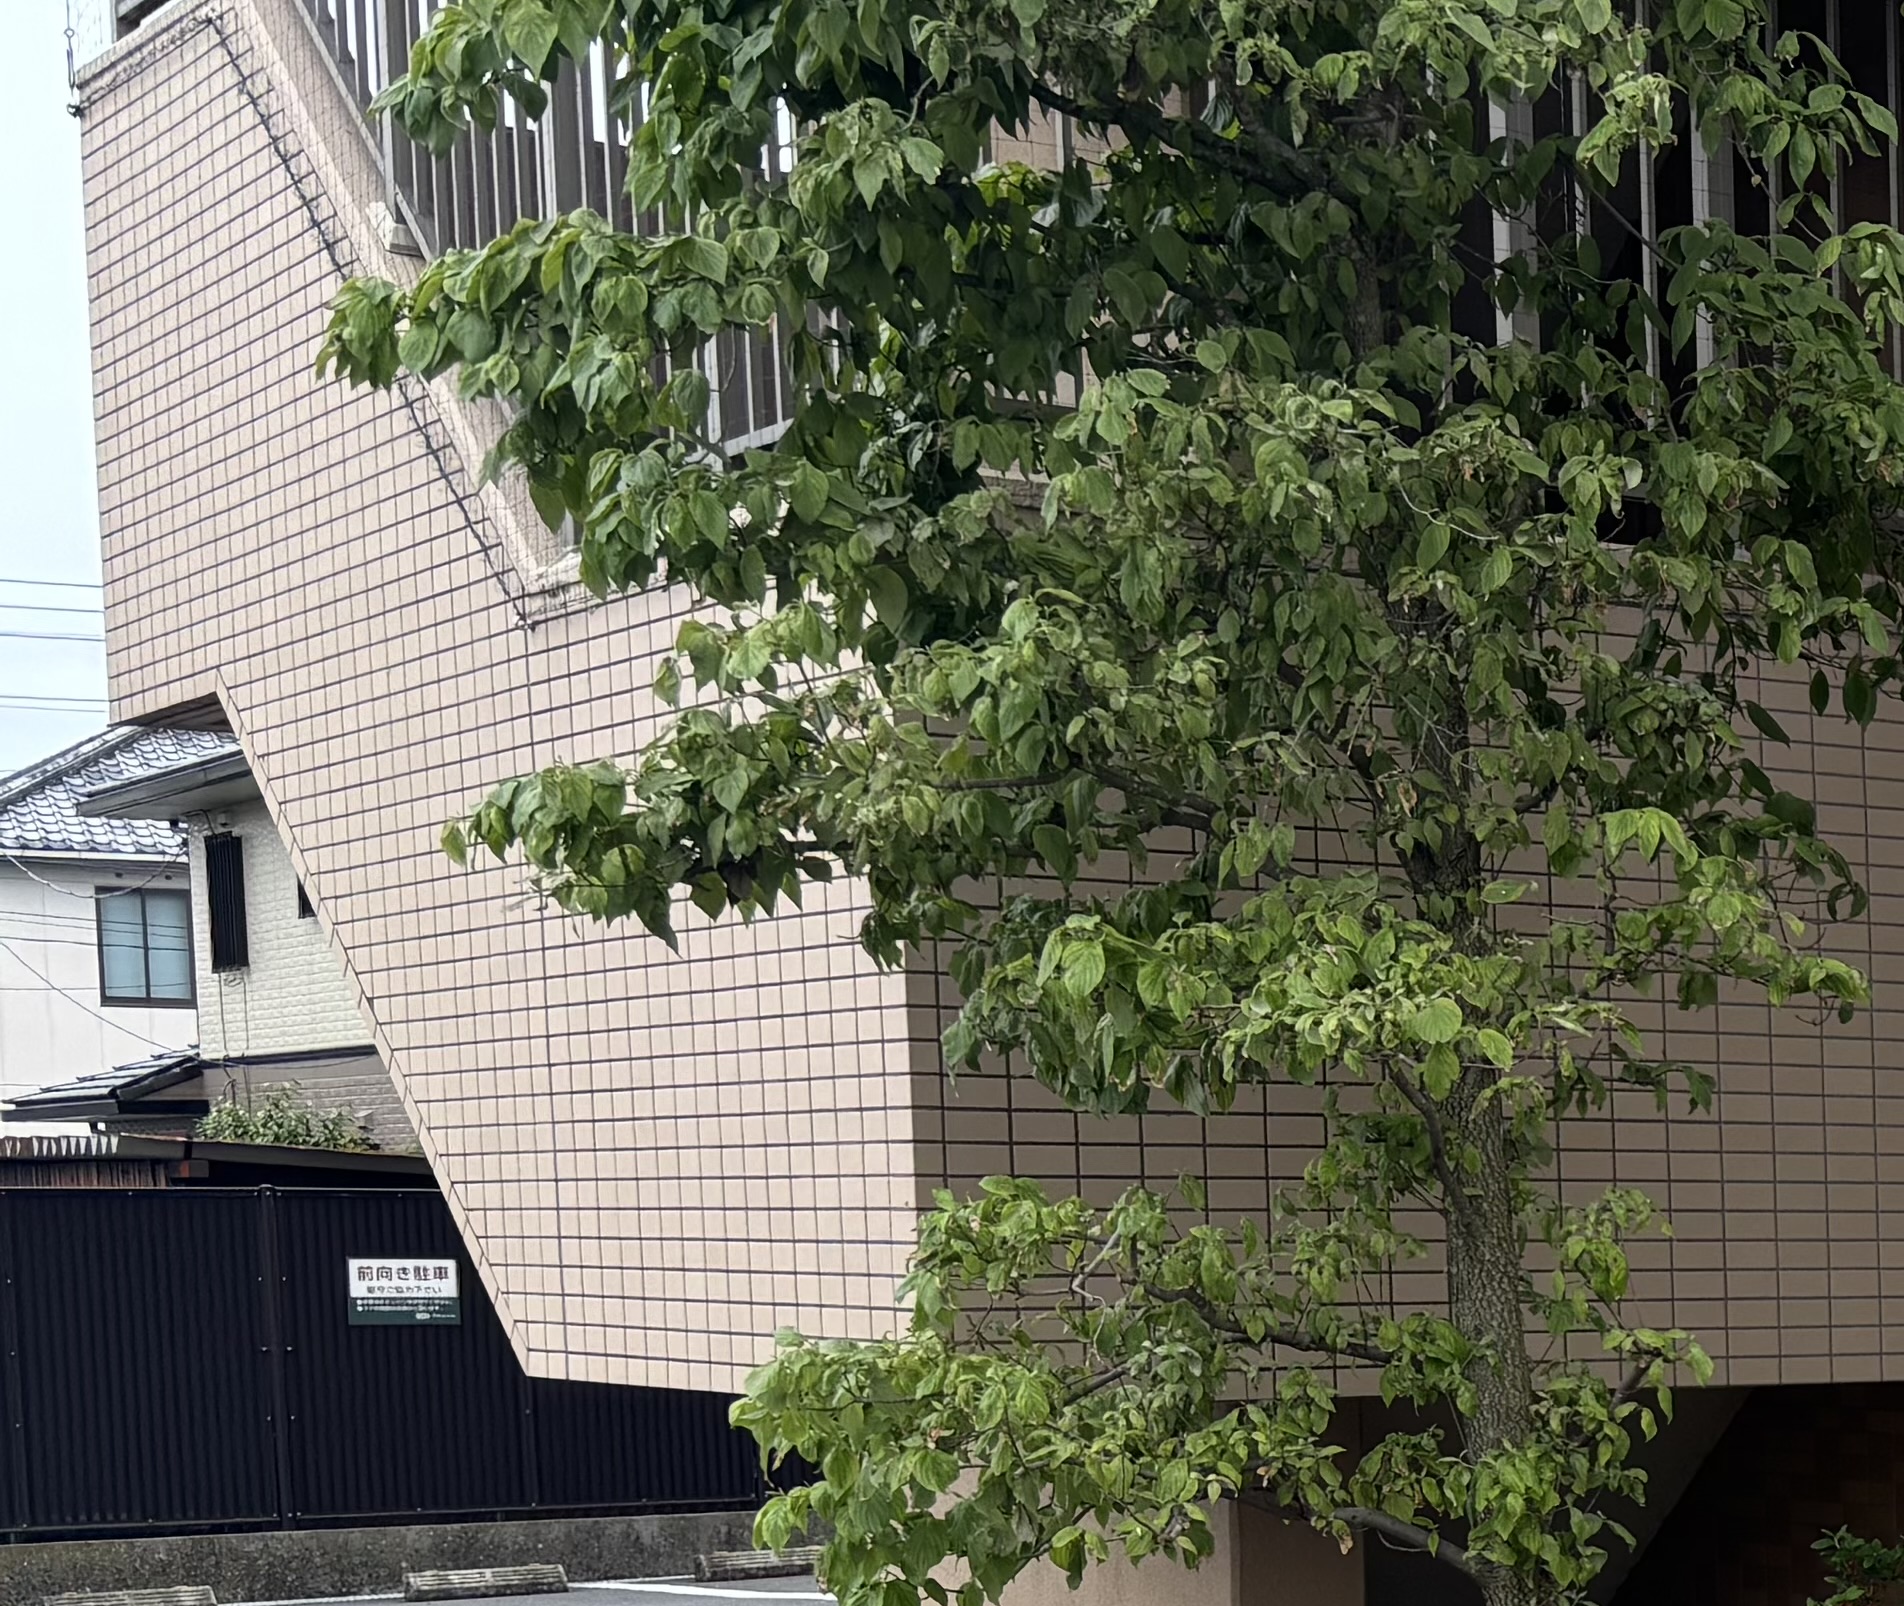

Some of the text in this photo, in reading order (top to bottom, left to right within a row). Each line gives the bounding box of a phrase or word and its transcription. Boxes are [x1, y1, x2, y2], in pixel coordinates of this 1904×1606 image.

[357, 1265, 449, 1281] 前向き駐車
